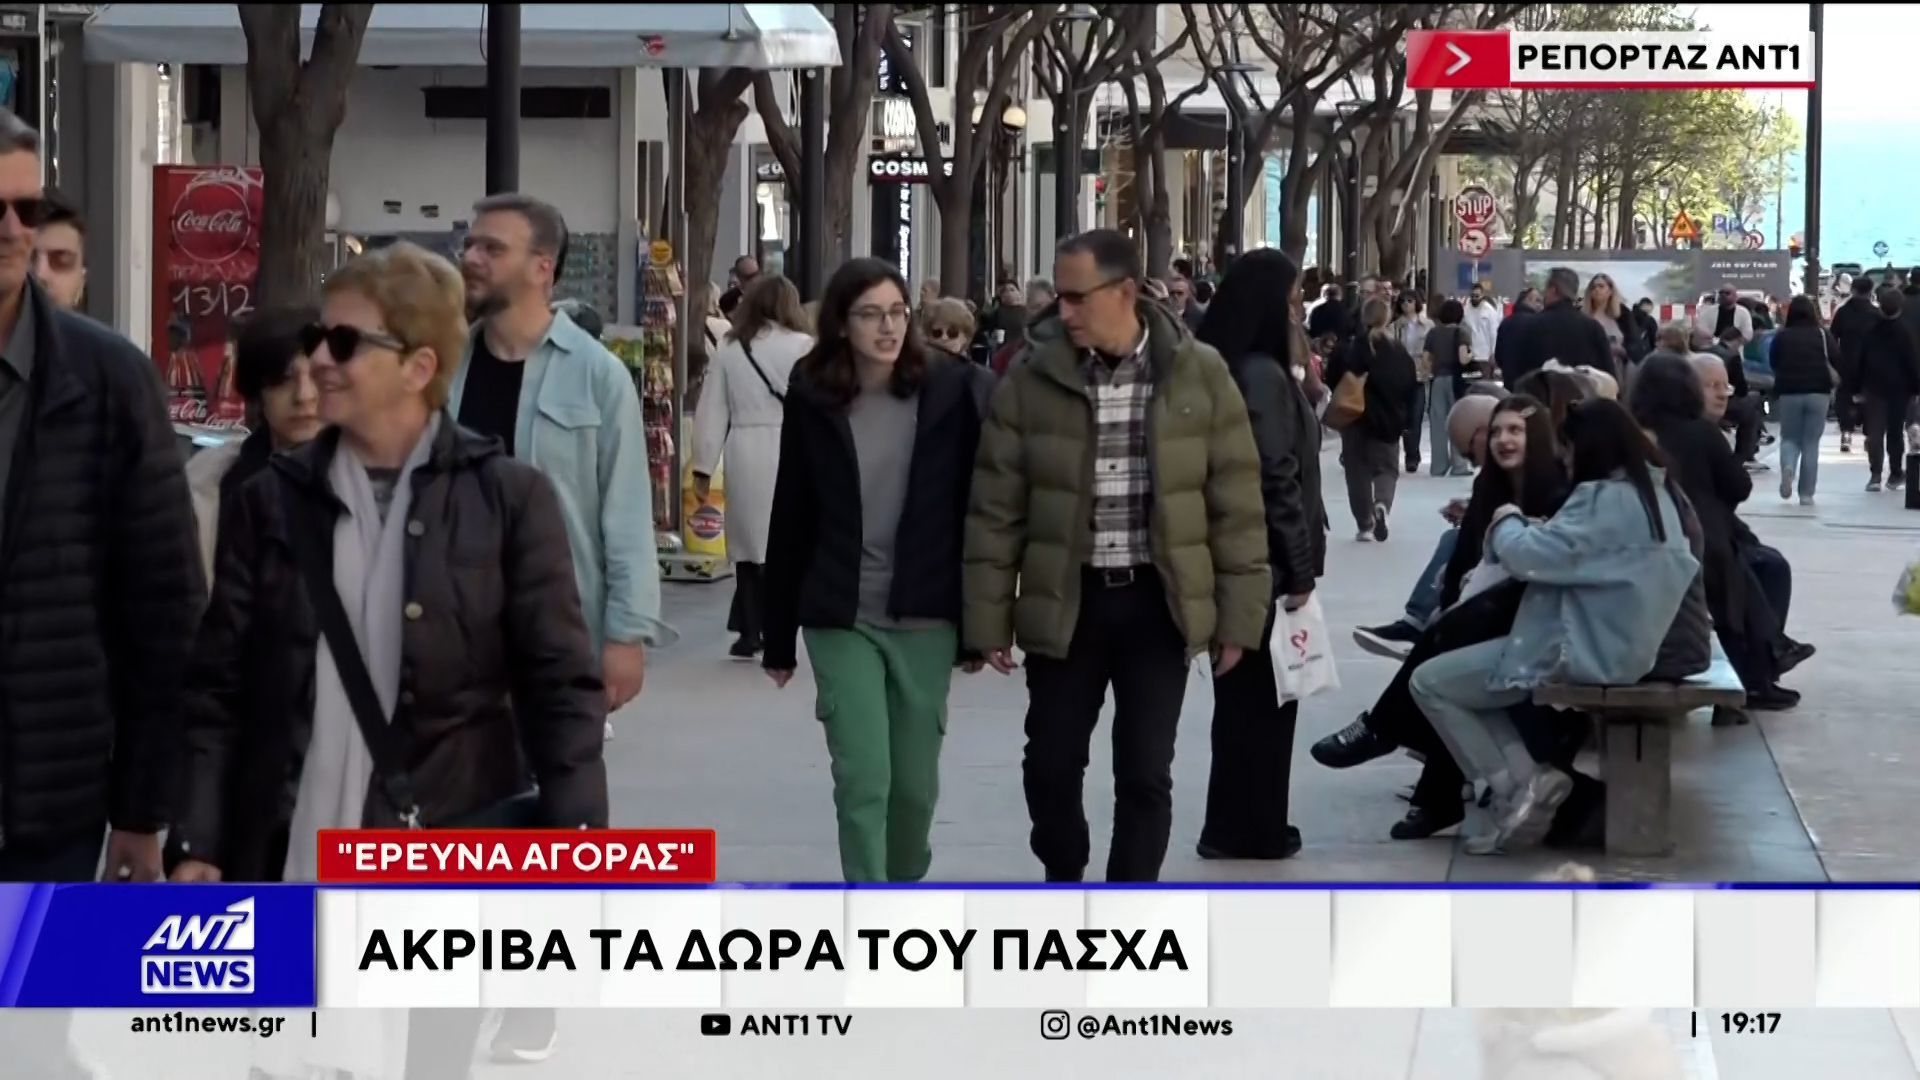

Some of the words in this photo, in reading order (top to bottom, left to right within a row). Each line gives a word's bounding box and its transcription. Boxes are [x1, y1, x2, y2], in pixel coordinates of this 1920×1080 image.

[871, 160, 954, 177] COSMS
[1457, 195, 1491, 216] STOP
[1752, 261, 1778, 269] team
